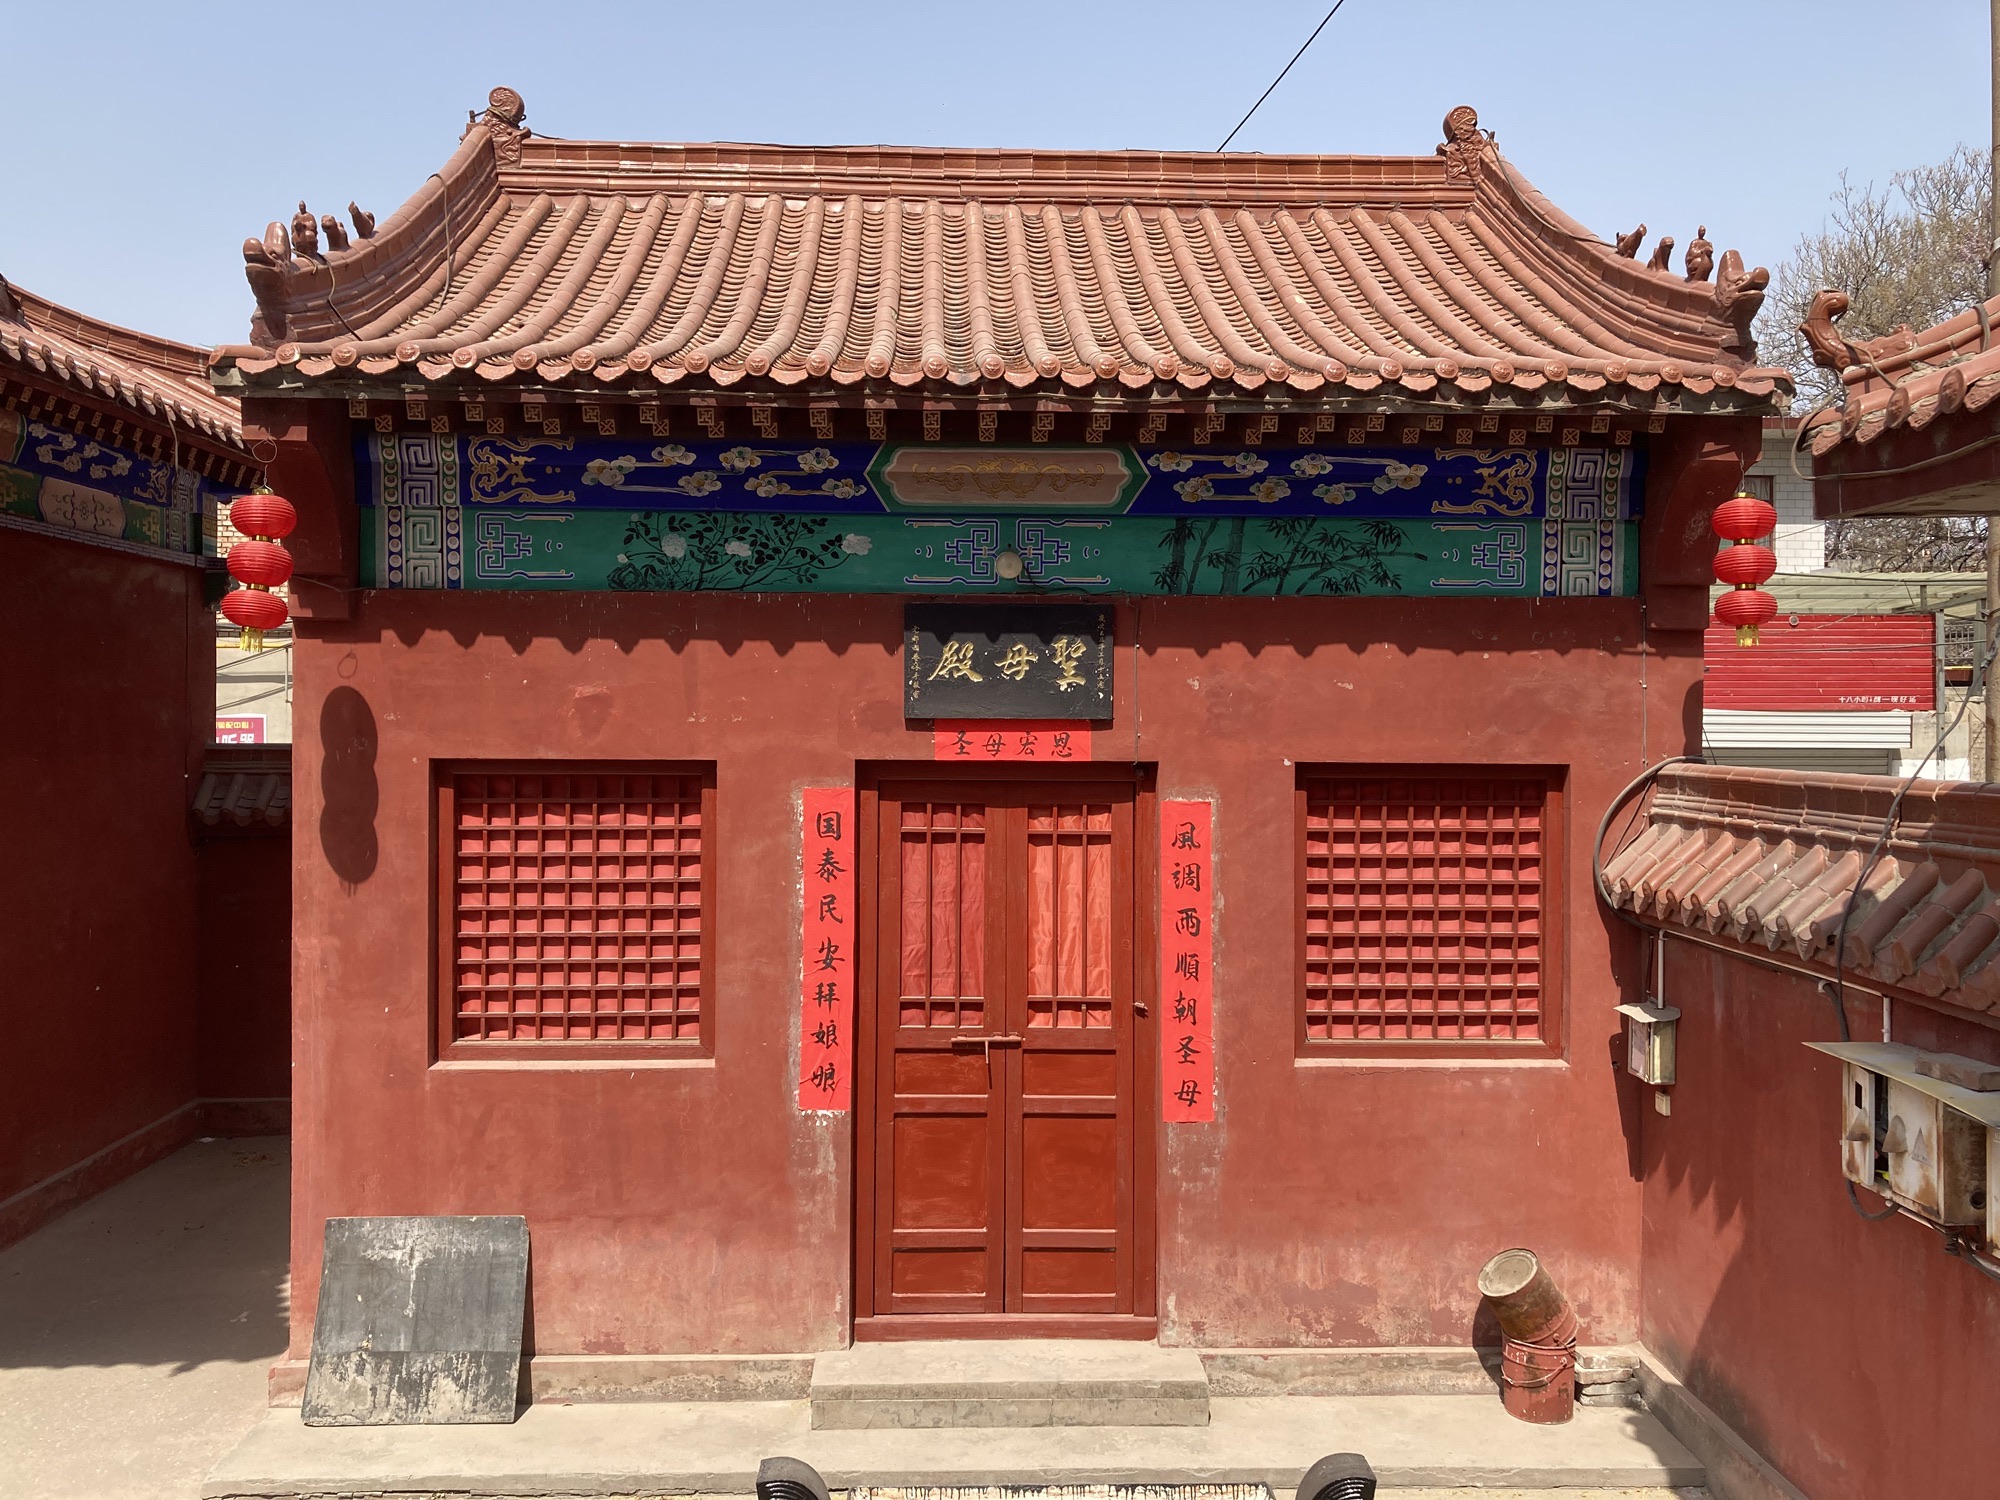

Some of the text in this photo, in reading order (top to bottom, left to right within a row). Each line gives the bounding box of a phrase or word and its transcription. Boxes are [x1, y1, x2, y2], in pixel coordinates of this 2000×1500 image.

[927, 635, 1087, 686] 聖母殿
[950, 730, 1074, 758] 圣母宏恩
[810, 811, 847, 1093] 国泰民安拜娘娘
